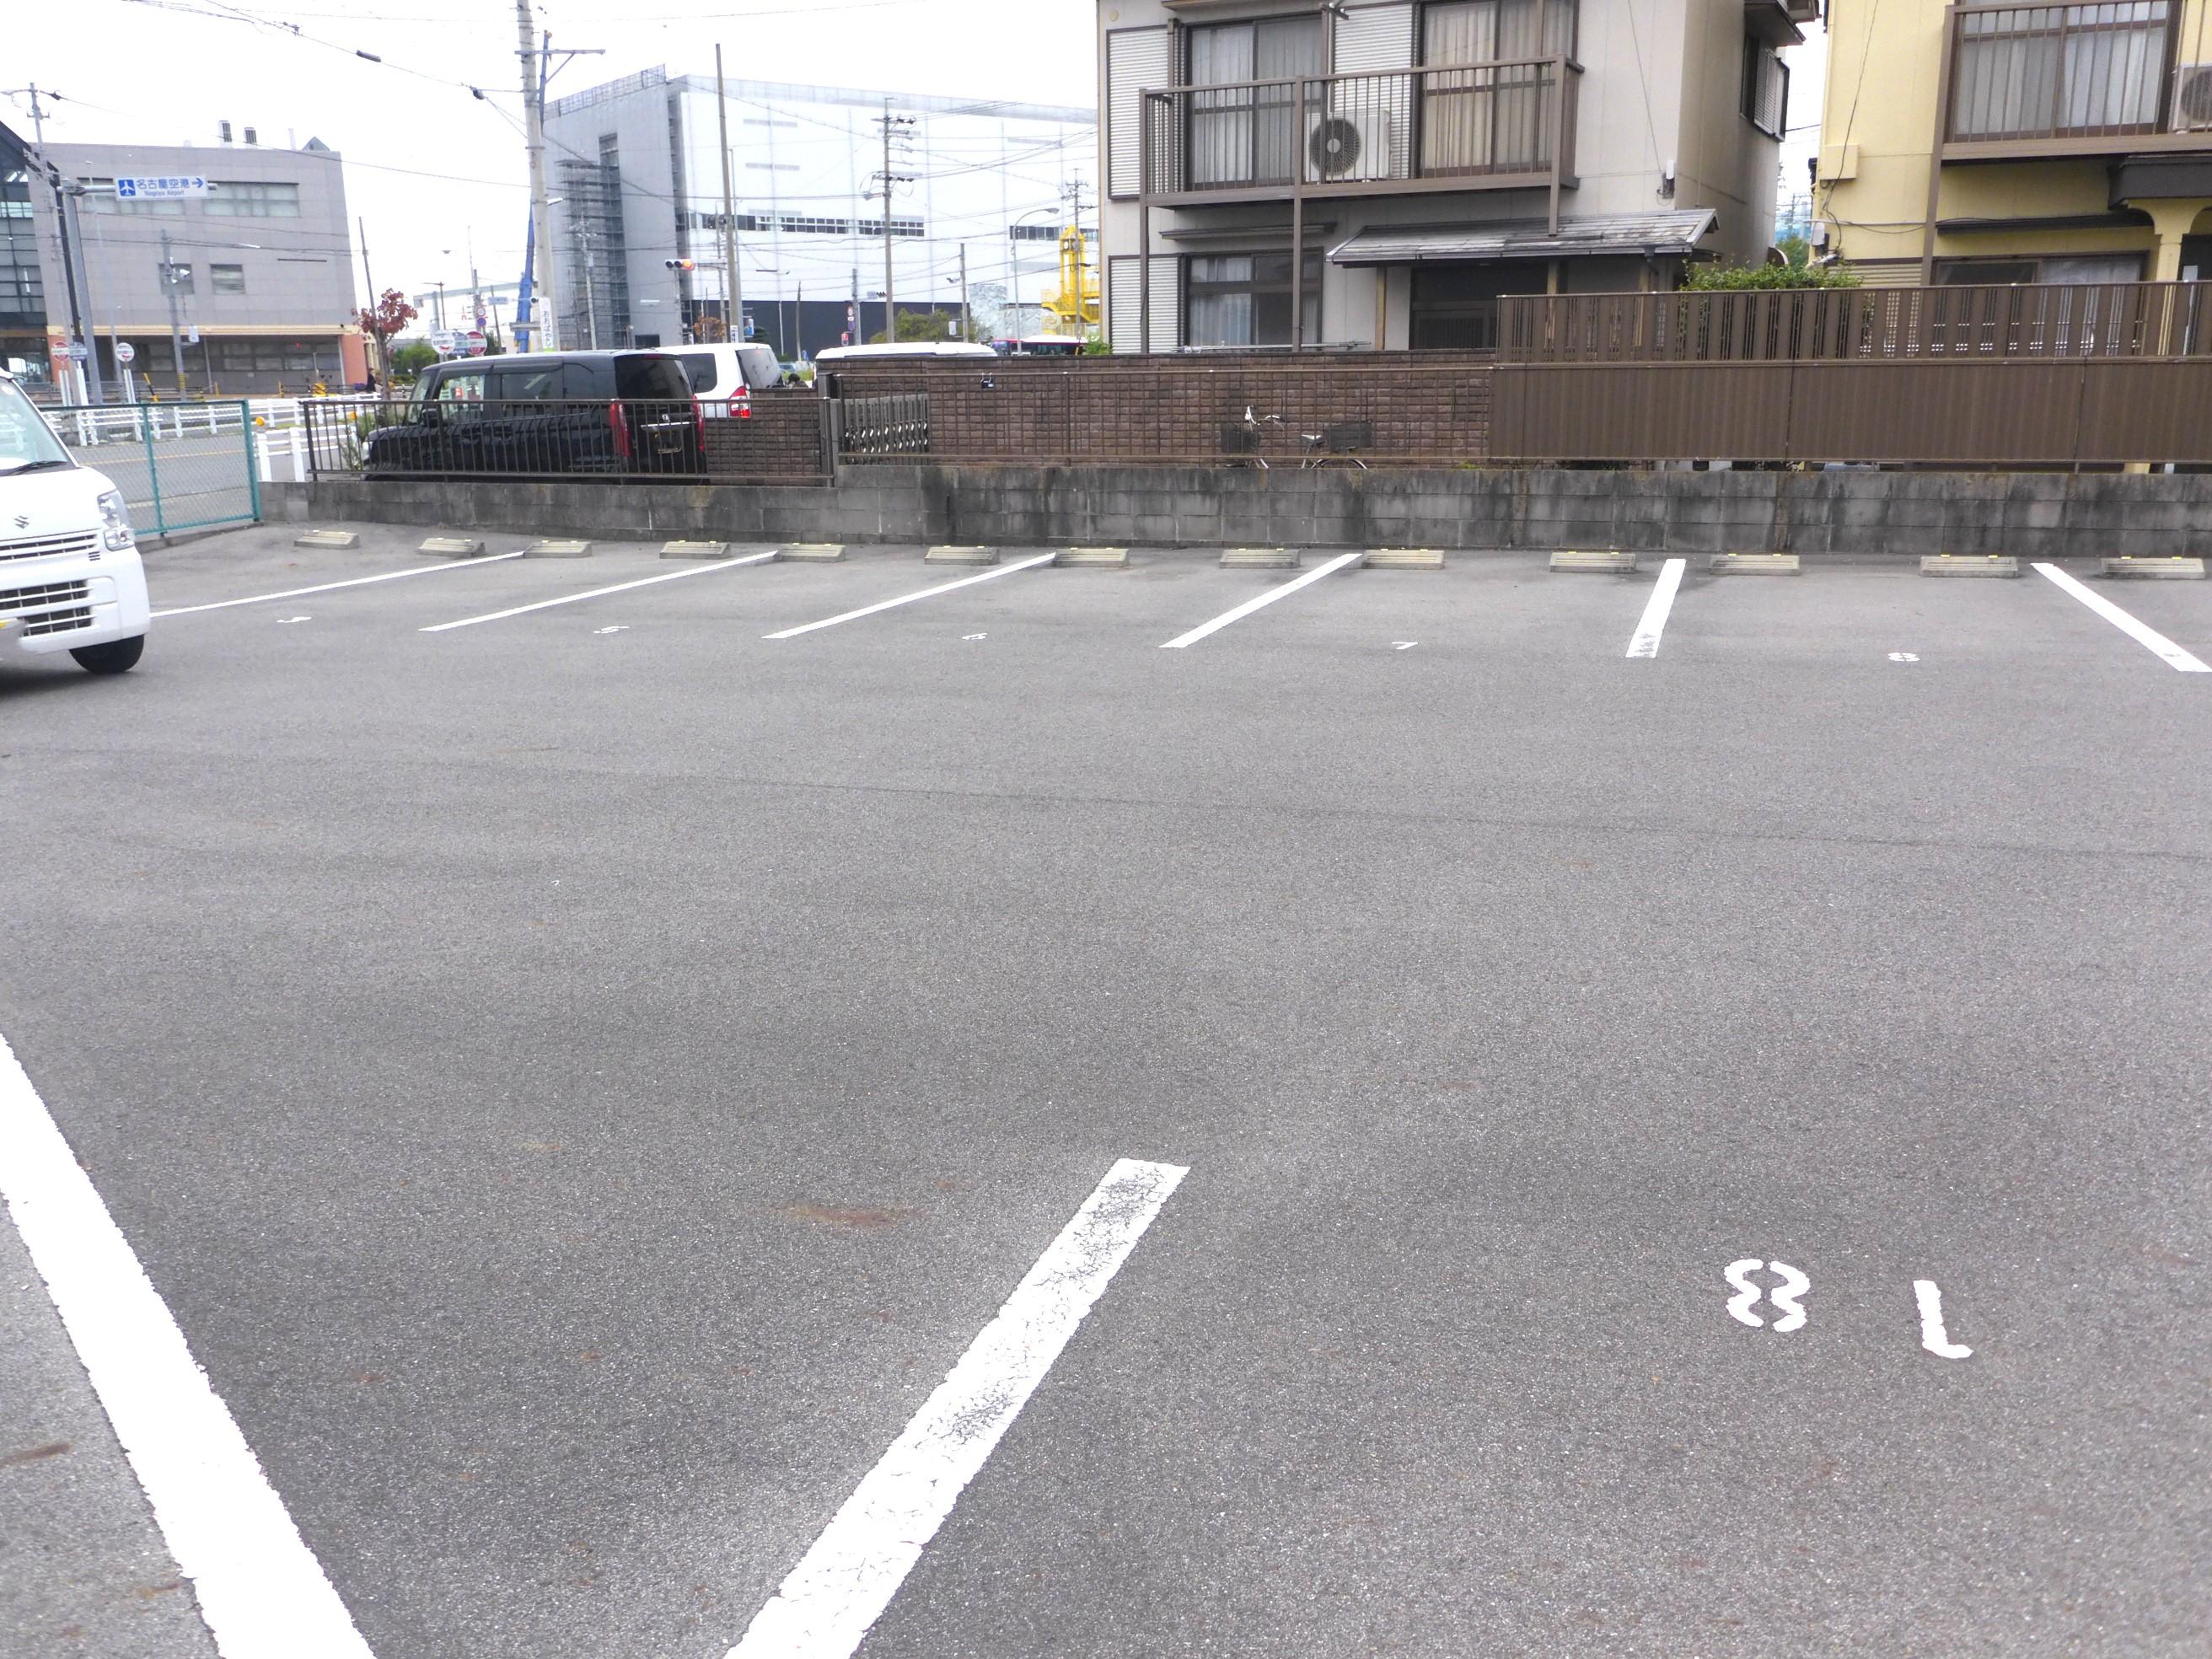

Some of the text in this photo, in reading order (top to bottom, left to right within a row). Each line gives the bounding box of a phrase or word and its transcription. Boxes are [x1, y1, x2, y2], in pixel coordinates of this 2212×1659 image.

[137, 179, 191, 190] 名古屋空港
[1391, 642, 1419, 650] 7
[1887, 652, 1920, 662] 8
